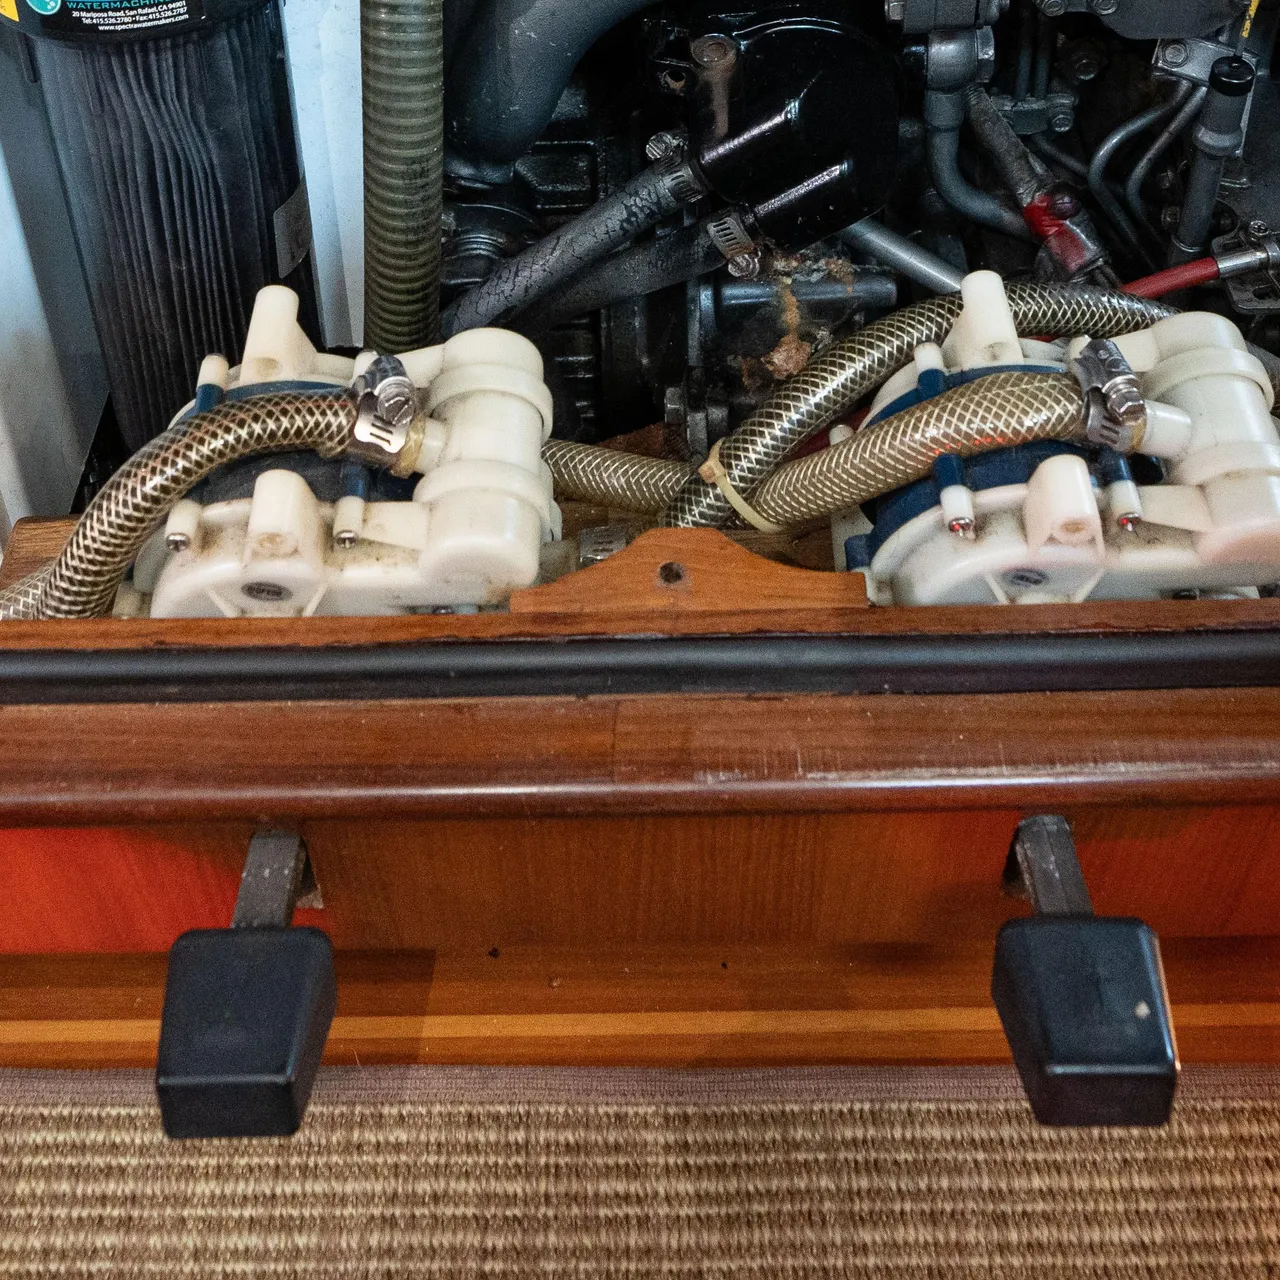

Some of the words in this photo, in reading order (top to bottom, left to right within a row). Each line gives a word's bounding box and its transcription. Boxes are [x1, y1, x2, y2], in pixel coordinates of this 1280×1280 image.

[80, 10, 106, 18] Mariposa
[168, 0, 186, 9] 94901
[98, 14, 188, 30] www.spectrawatermakers.com
